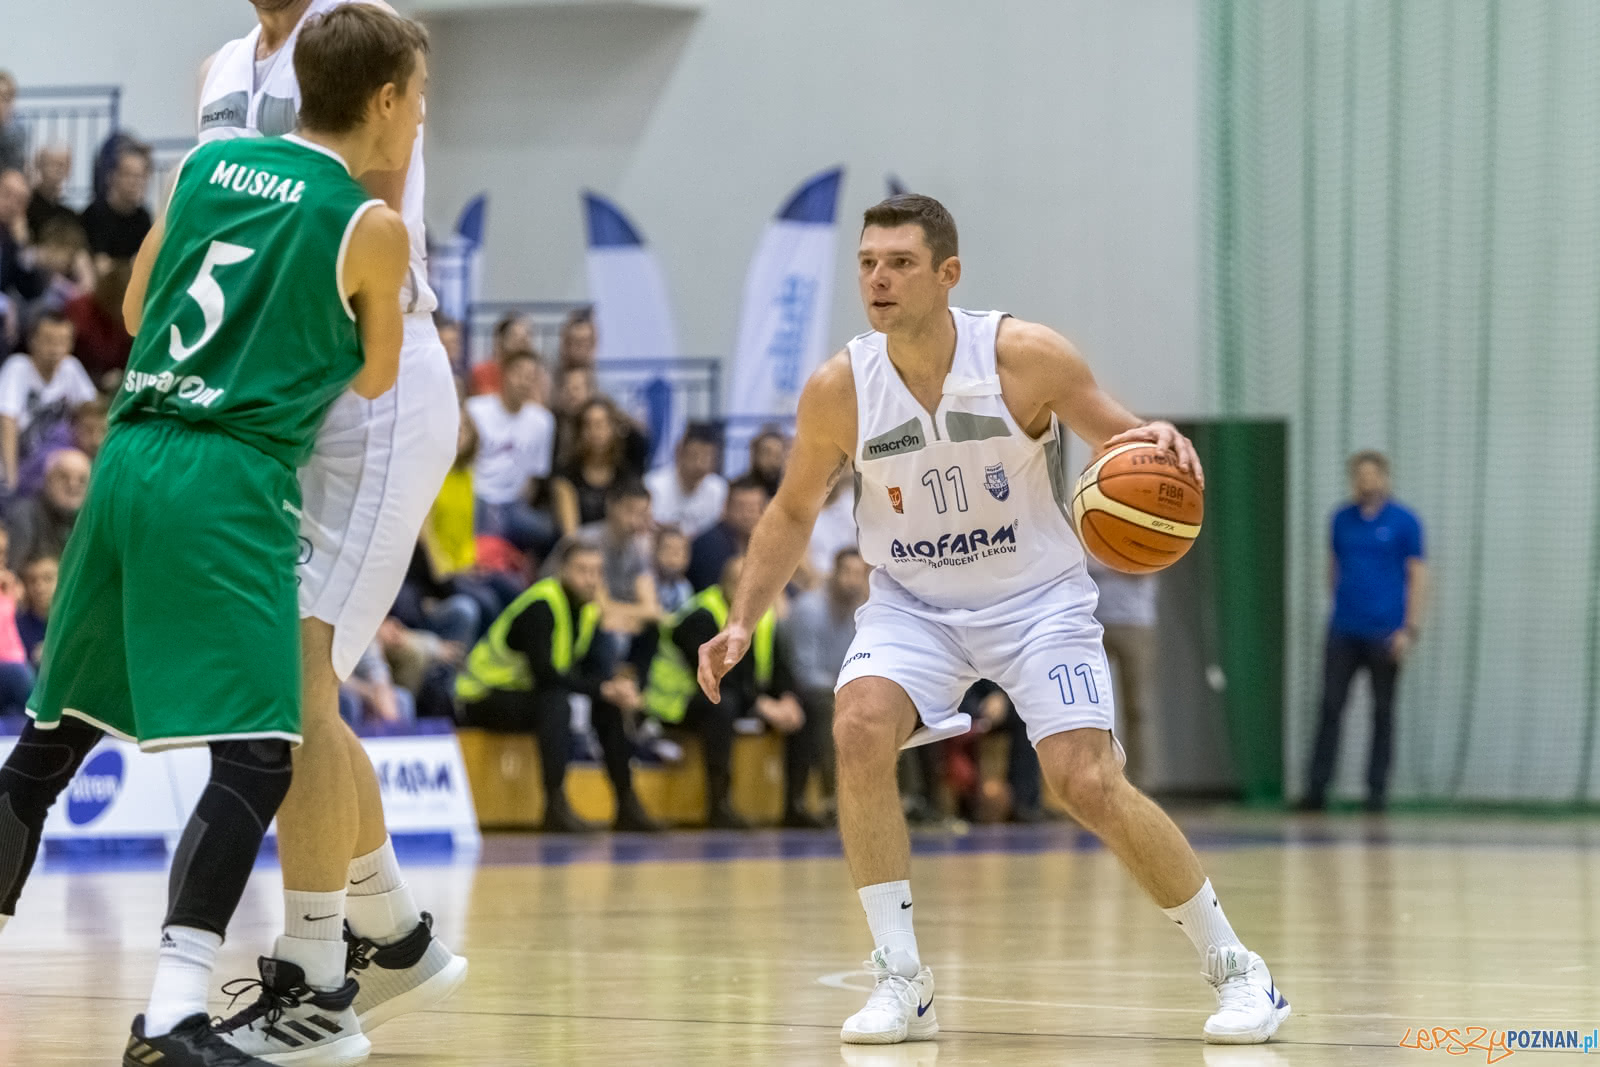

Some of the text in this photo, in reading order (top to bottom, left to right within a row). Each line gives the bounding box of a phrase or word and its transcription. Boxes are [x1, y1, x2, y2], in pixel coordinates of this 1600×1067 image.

[209, 160, 305, 203] MUSIAŁ
[168, 240, 256, 362] 5
[868, 434, 919, 455] macron
[922, 466, 968, 514] 11
[891, 524, 1016, 558] BIOFARM
[928, 553, 979, 568] PRODUCENT
[982, 545, 1016, 558] LEKÓW
[1048, 663, 1099, 705] 11
